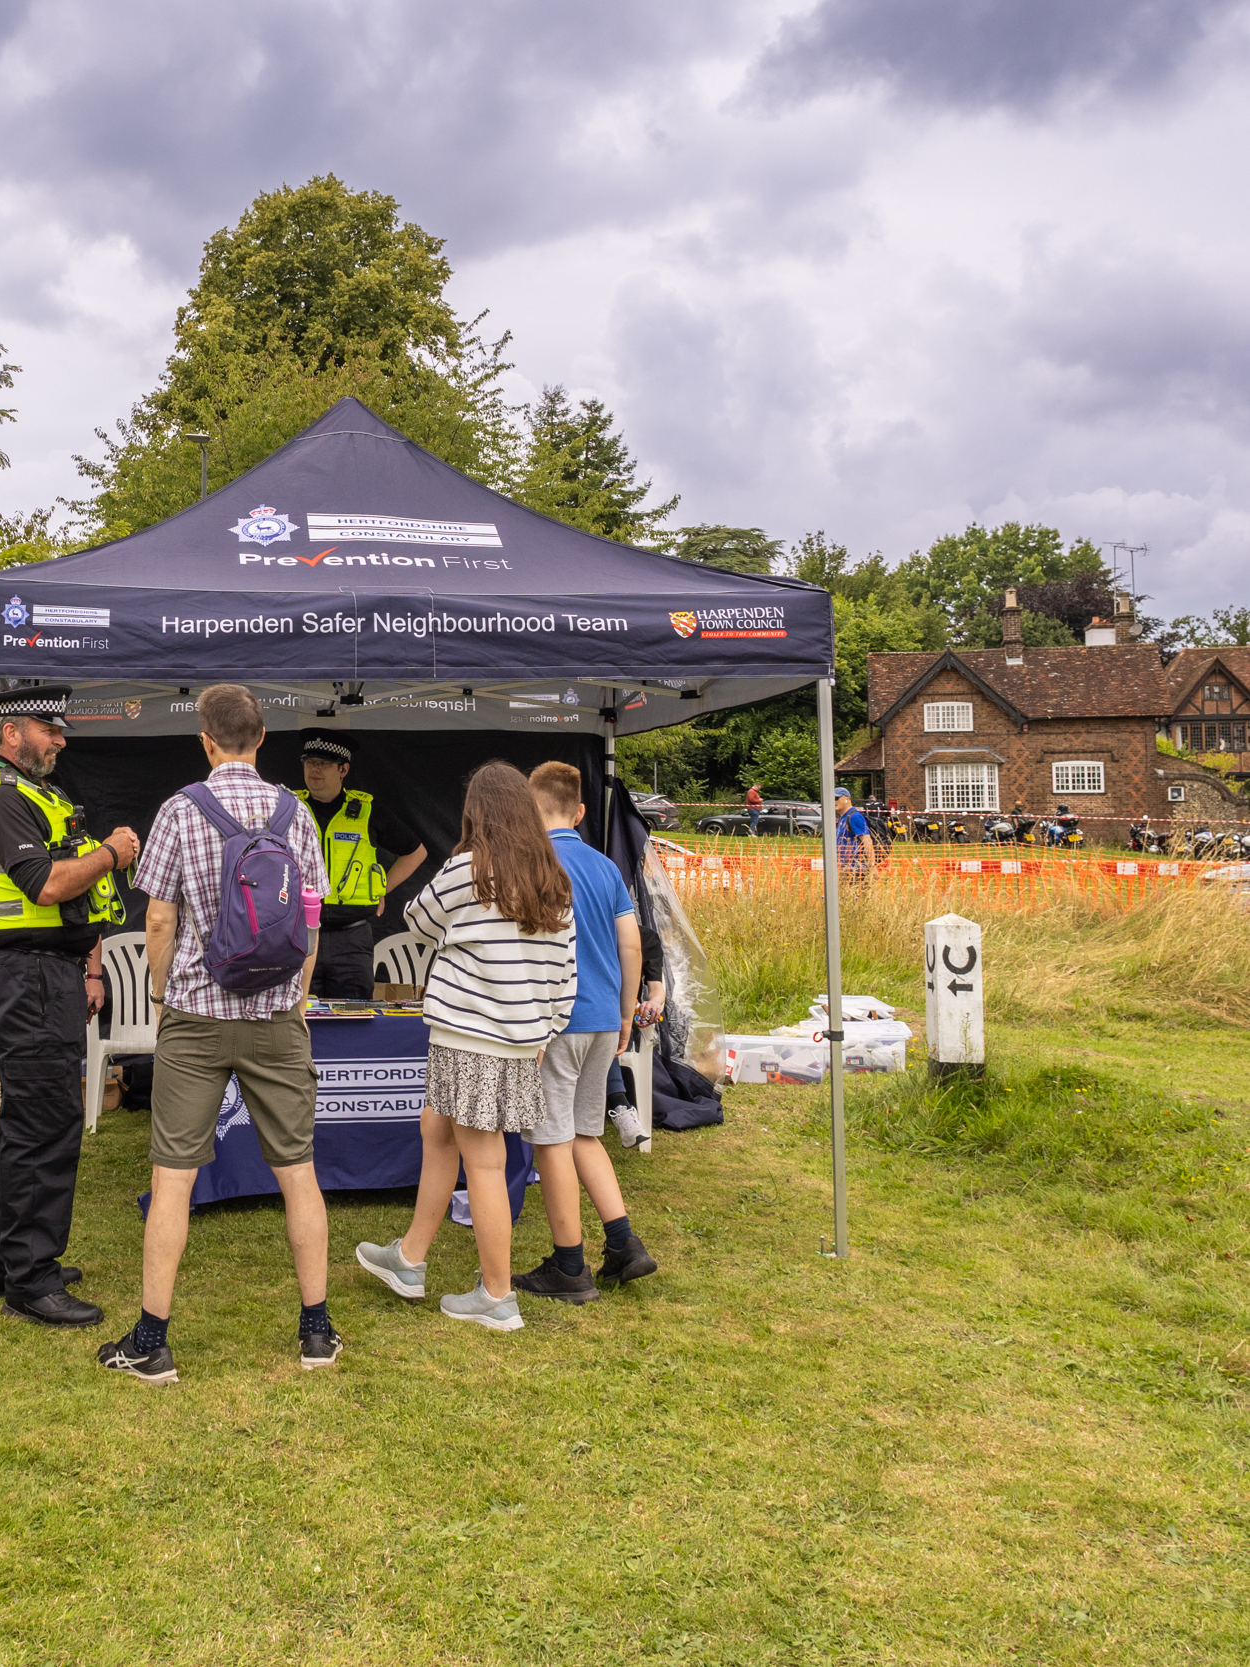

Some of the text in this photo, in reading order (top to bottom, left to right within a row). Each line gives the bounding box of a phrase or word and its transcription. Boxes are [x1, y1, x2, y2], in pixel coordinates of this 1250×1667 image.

[337, 518, 467, 531] HERTFORDSHIRE
[339, 531, 471, 542] CONSTABULARY
[238, 546, 513, 570] Prevention First
[696, 606, 785, 620] HARPENDEN
[161, 612, 628, 638] Harpenden Safer Neighbourhood Team
[698, 618, 786, 630] TOWN COUNCIL
[3, 630, 109, 650] Prevention First
[335, 833, 360, 841] POLICE
[281, 863, 289, 892] berghaus
[314, 1098, 426, 1113] CONSTABU
